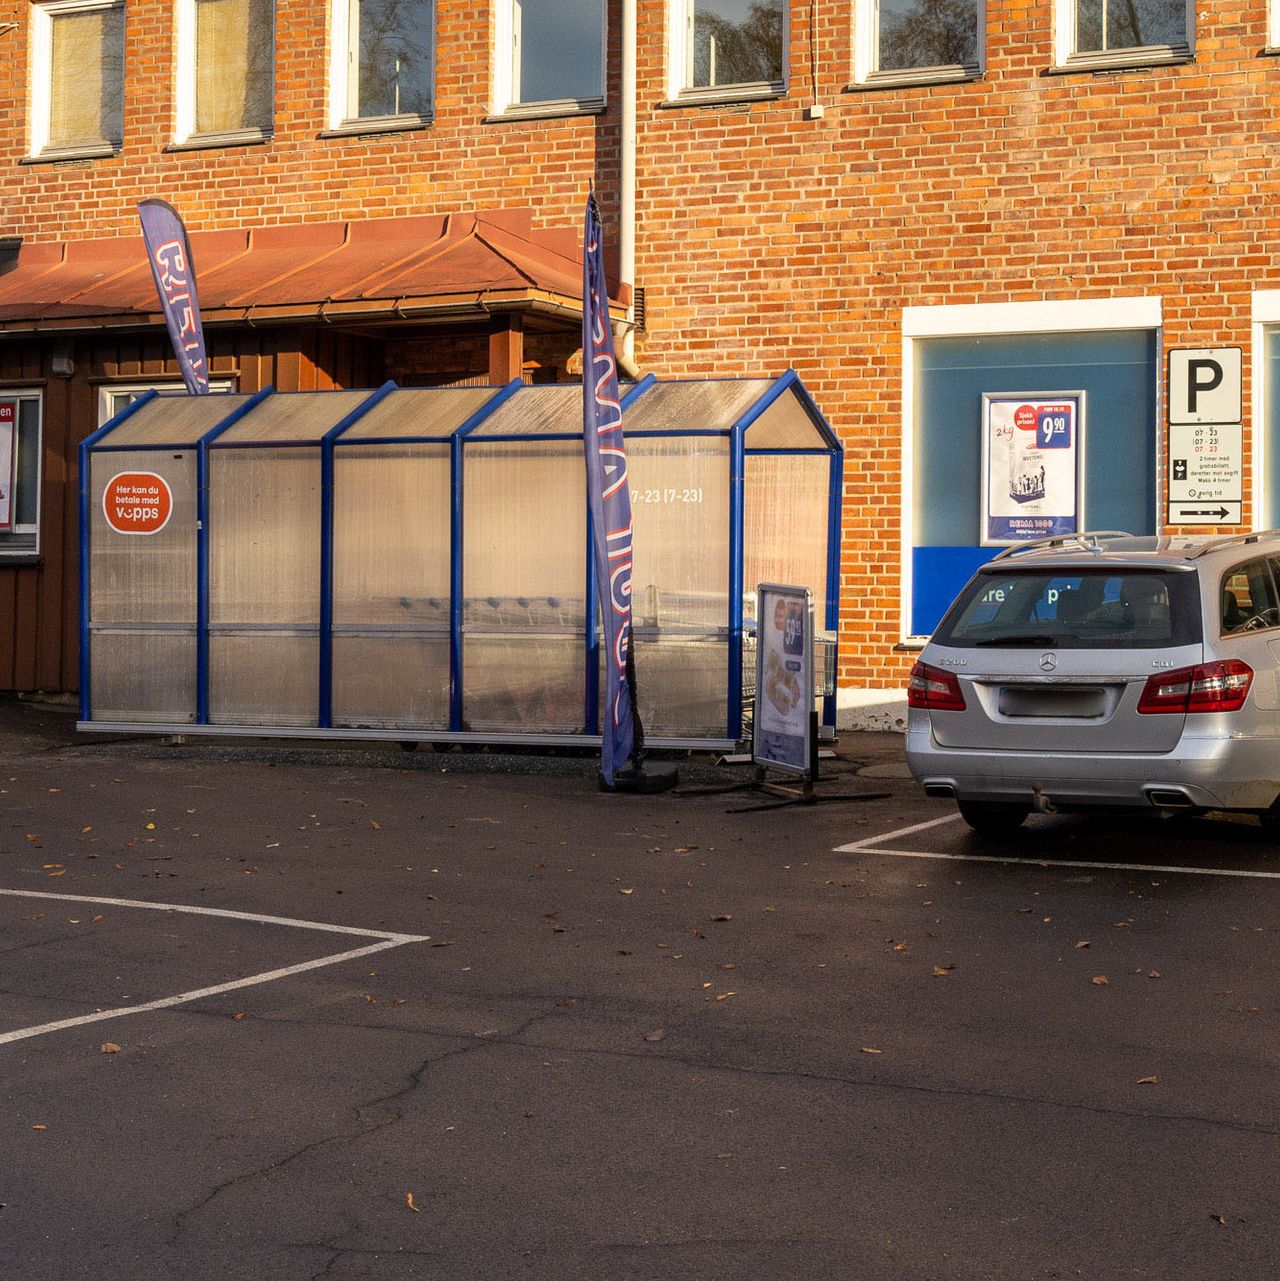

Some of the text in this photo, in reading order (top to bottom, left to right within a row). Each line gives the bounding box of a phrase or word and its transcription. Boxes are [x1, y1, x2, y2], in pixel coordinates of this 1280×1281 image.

[1187, 358, 1223, 413] P
[1042, 417, 1065, 443] 9 90
[132, 486, 147, 494] kan
[148, 486, 159, 494] du
[115, 495, 160, 504] betale med
[631, 488, 703, 504] 7-23 (7-23)
[1009, 519, 1053, 528] REMA 1000
[1151, 660, 1174, 668] CDI
